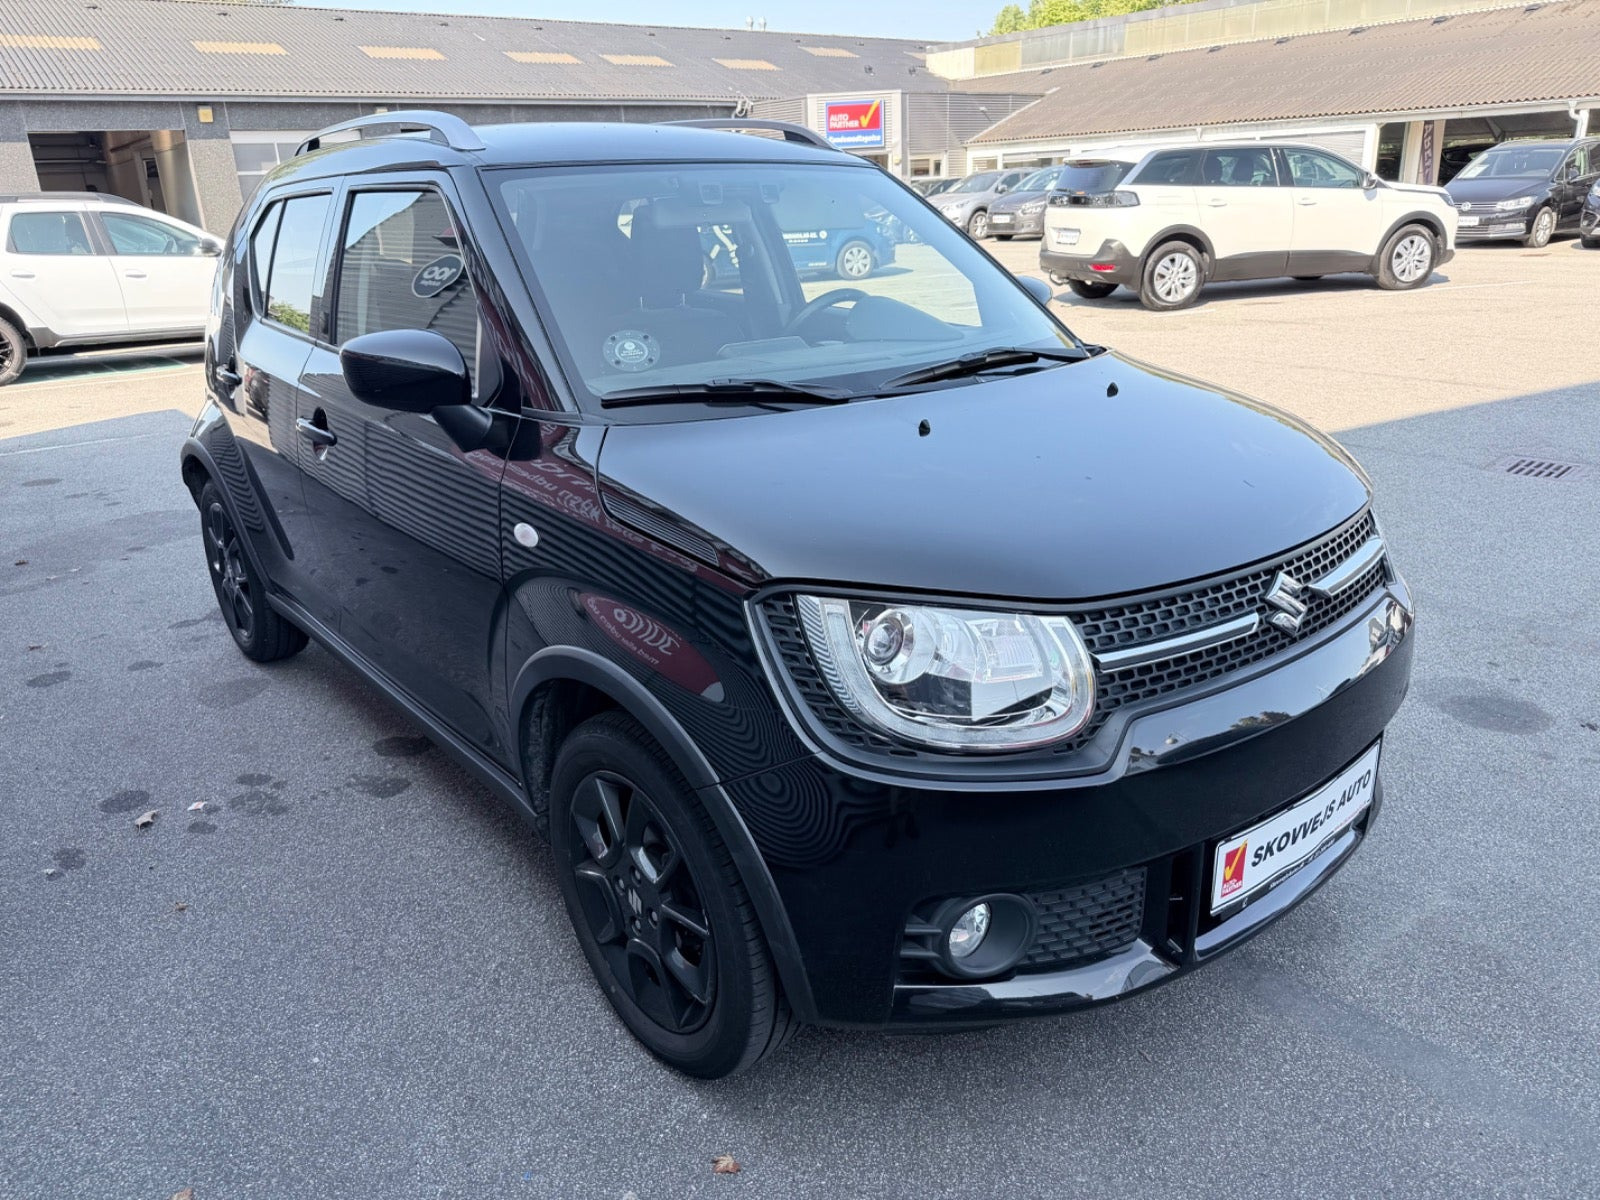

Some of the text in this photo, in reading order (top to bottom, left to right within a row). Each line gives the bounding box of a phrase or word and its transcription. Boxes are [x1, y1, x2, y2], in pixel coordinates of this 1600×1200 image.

[830, 120, 859, 128] PARTNER
[1251, 799, 1336, 868] SKOVVEJS
[1336, 768, 1372, 812] AUTO
